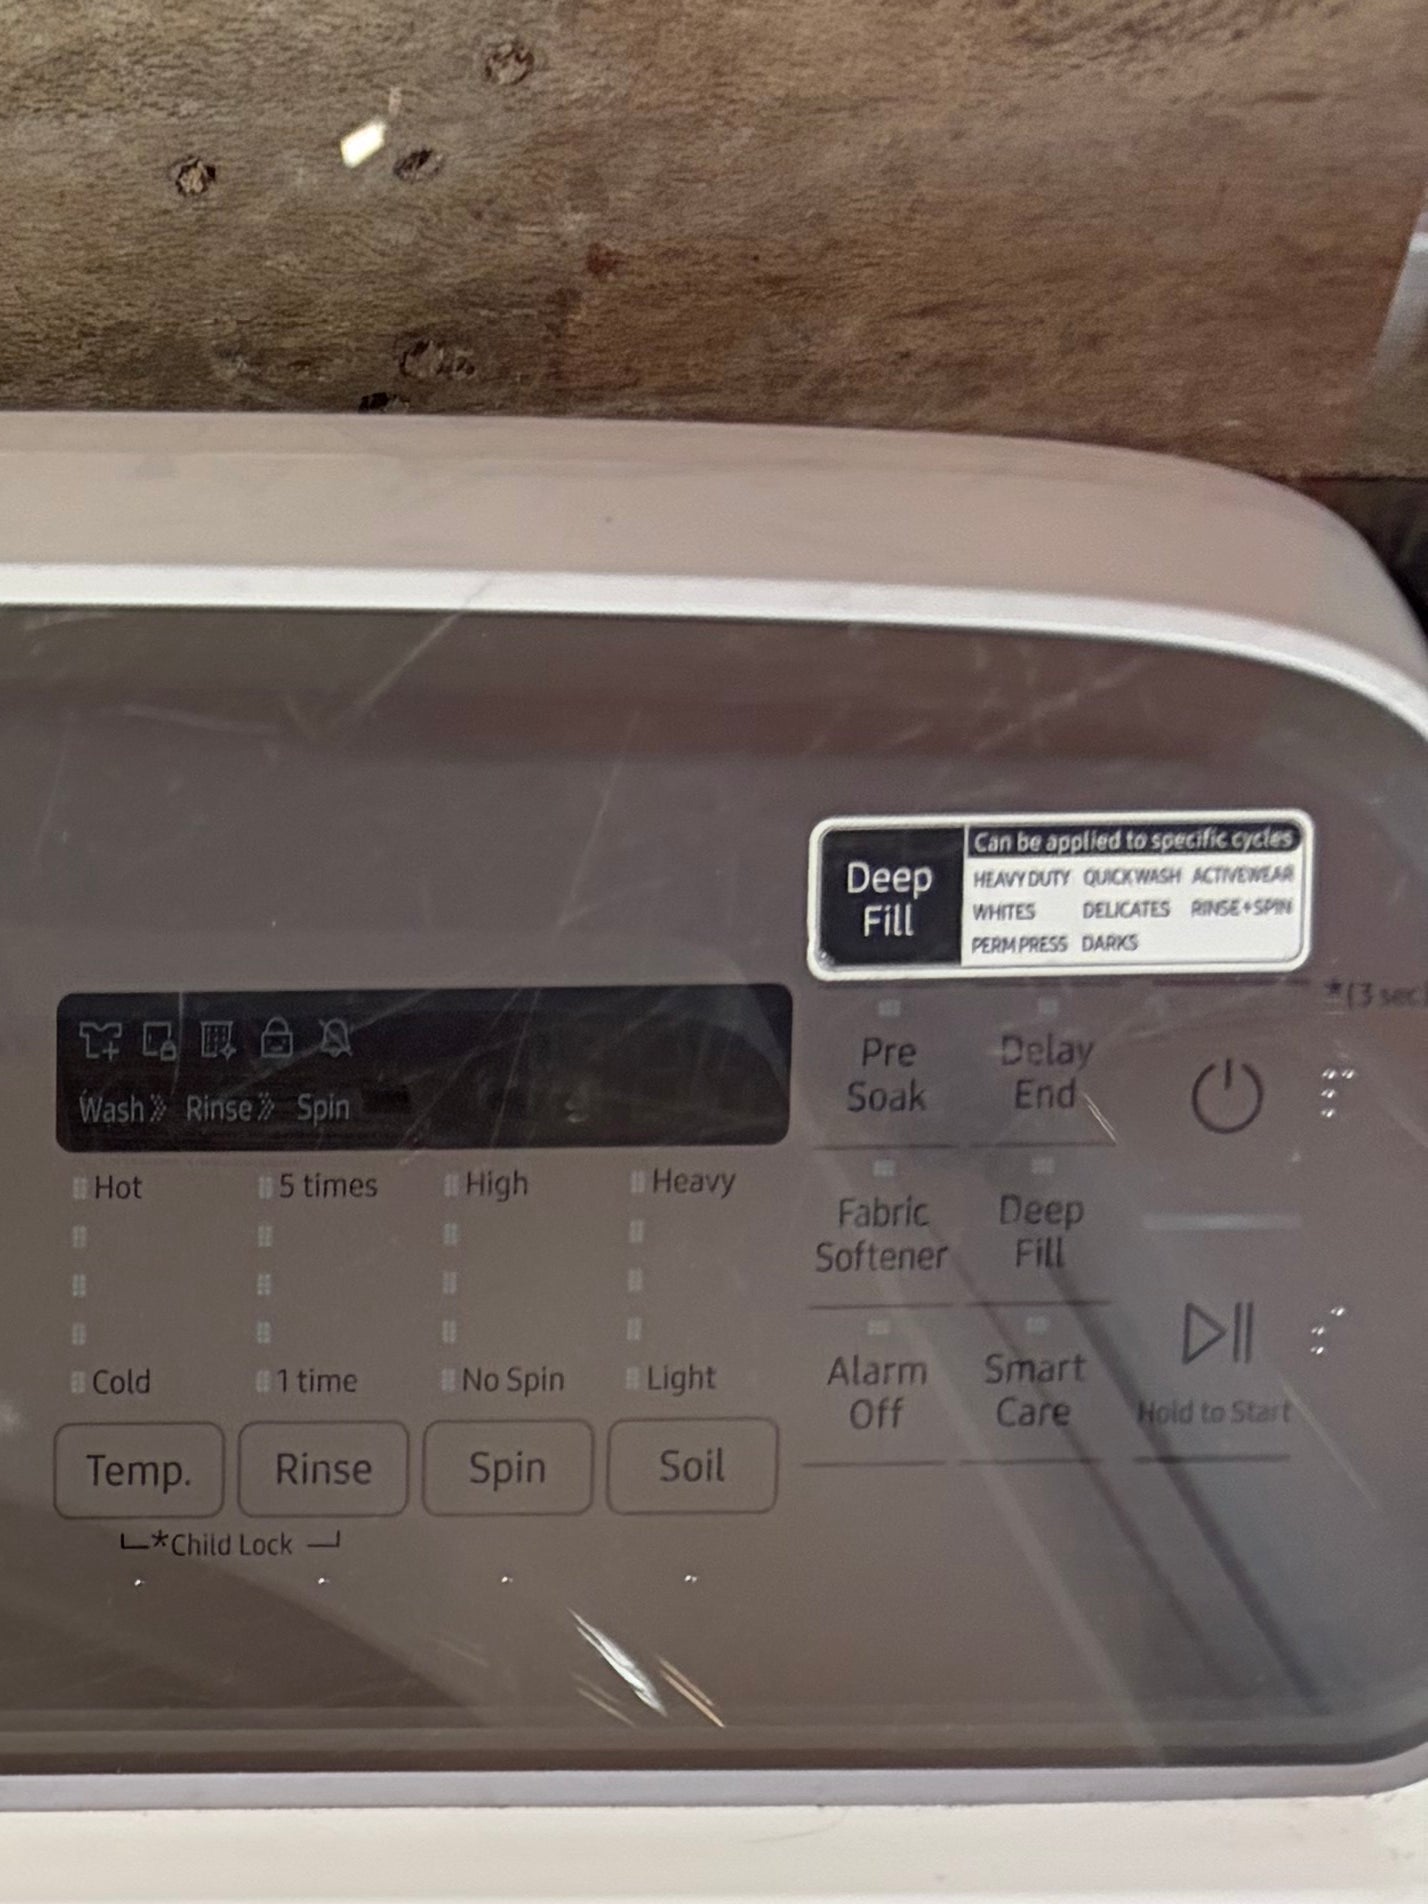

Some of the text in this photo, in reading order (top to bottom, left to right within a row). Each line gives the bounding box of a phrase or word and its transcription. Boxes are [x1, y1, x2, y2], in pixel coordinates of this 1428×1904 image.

[974, 827, 1293, 855] Can be applied to specific cycles
[847, 861, 932, 899] Deep
[864, 905, 913, 938] Fill
[974, 903, 1035, 921] WHITES
[1084, 901, 1170, 919] DELICATES
[973, 935, 1139, 954] PERM PRESS DARKS
[862, 1037, 917, 1067] Pre
[1001, 1035, 1092, 1073] Delay
[80, 1091, 350, 1126] Wash Rinse Spin
[847, 1081, 926, 1112] Soak
[1015, 1079, 1076, 1109] End
[94, 1174, 141, 1200] Hot
[280, 1173, 378, 1199] 5 times
[466, 1170, 528, 1202] High
[652, 1169, 735, 1199] Heavy
[840, 1197, 929, 1228] Fabric
[1000, 1194, 1084, 1232] Deep
[815, 1241, 948, 1274] Softener
[1016, 1237, 1065, 1269] Fill
[92, 1368, 151, 1396] Cold
[278, 1368, 358, 1394] 1 time
[463, 1367, 565, 1399] No Spin
[647, 1366, 716, 1398] Light
[827, 1354, 926, 1385] Alarm
[985, 1351, 1086, 1384] Smart
[850, 1397, 904, 1430] Off
[996, 1396, 1071, 1428] Care
[1137, 1401, 1291, 1424] Hold to Start
[87, 1453, 192, 1493] Temp.
[276, 1453, 372, 1486] Rinse
[469, 1451, 546, 1491] Spin
[659, 1449, 724, 1483] Soil
[240, 1530, 292, 1556] Lock
